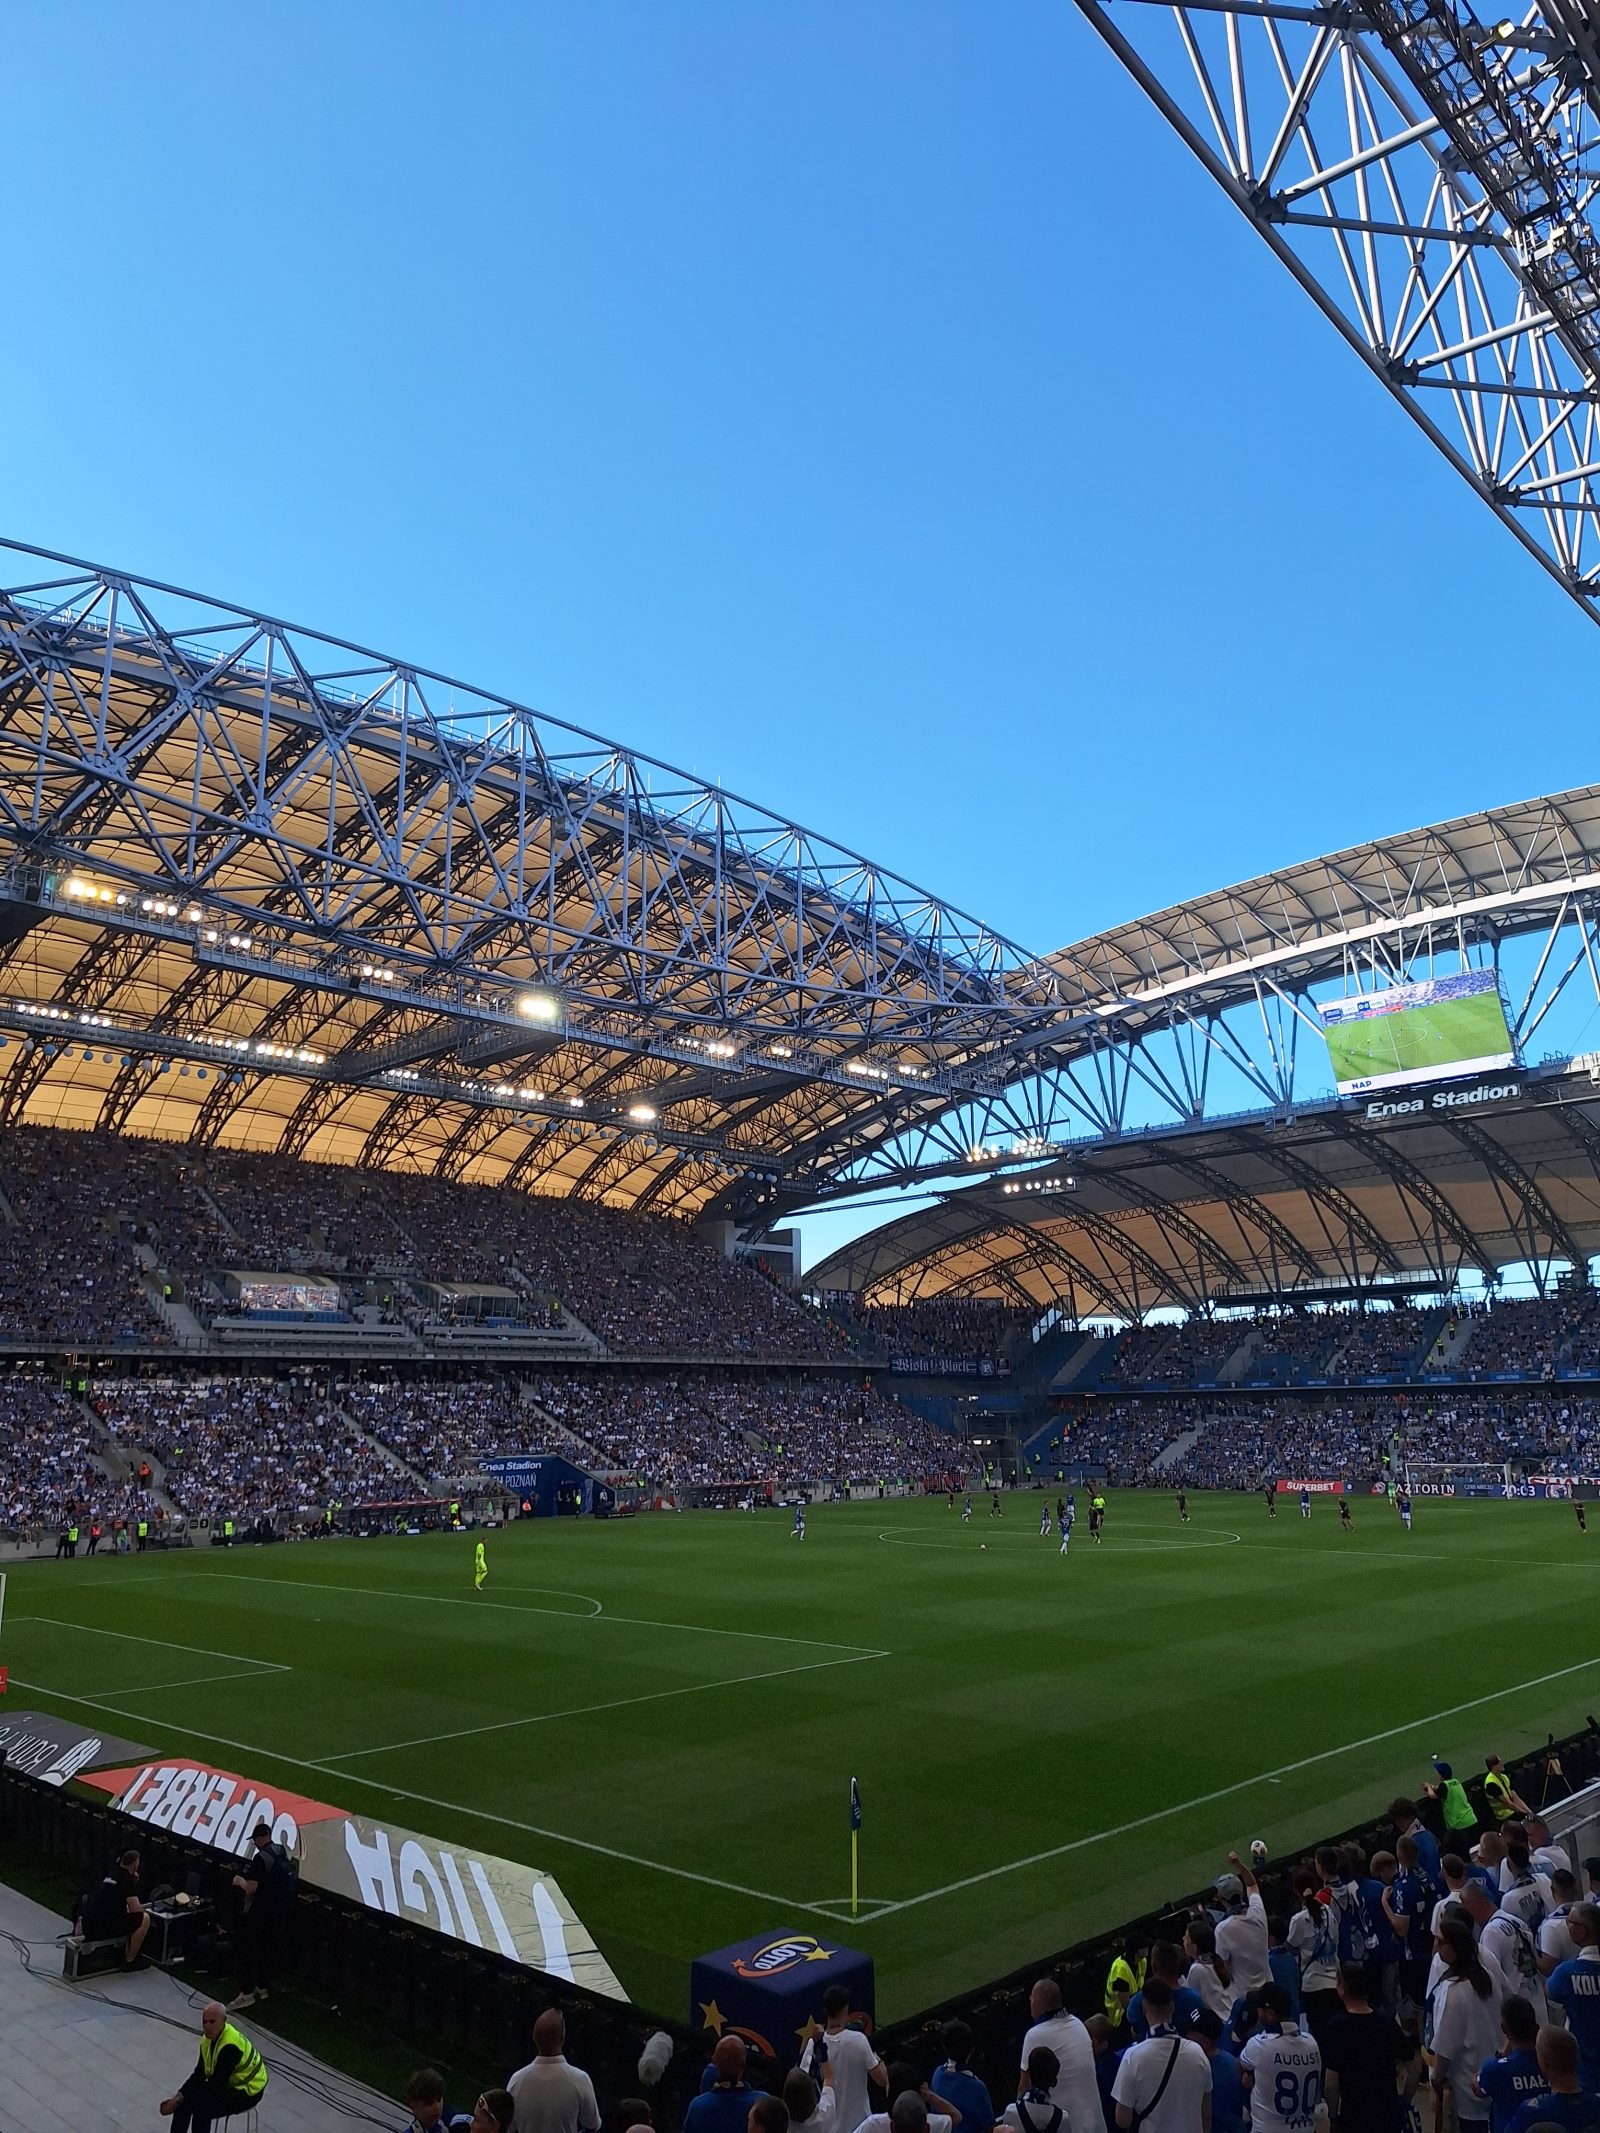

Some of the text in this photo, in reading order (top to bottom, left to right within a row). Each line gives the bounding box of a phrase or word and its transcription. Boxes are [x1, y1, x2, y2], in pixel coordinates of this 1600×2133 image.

[1351, 1080, 1372, 1090] NAP
[1366, 1083, 1519, 1119] Enea Stadion
[478, 1460, 542, 1471] Enea Stadion
[505, 1472, 537, 1488] POZNAŃ
[1286, 1481, 1335, 1492] SUPERBET
[118, 1766, 298, 1859] SUPERBET
[753, 1943, 812, 1970] LOTTO
[1512, 2071, 1553, 2091] BIAŁ
[1275, 2071, 1320, 2116] 80
